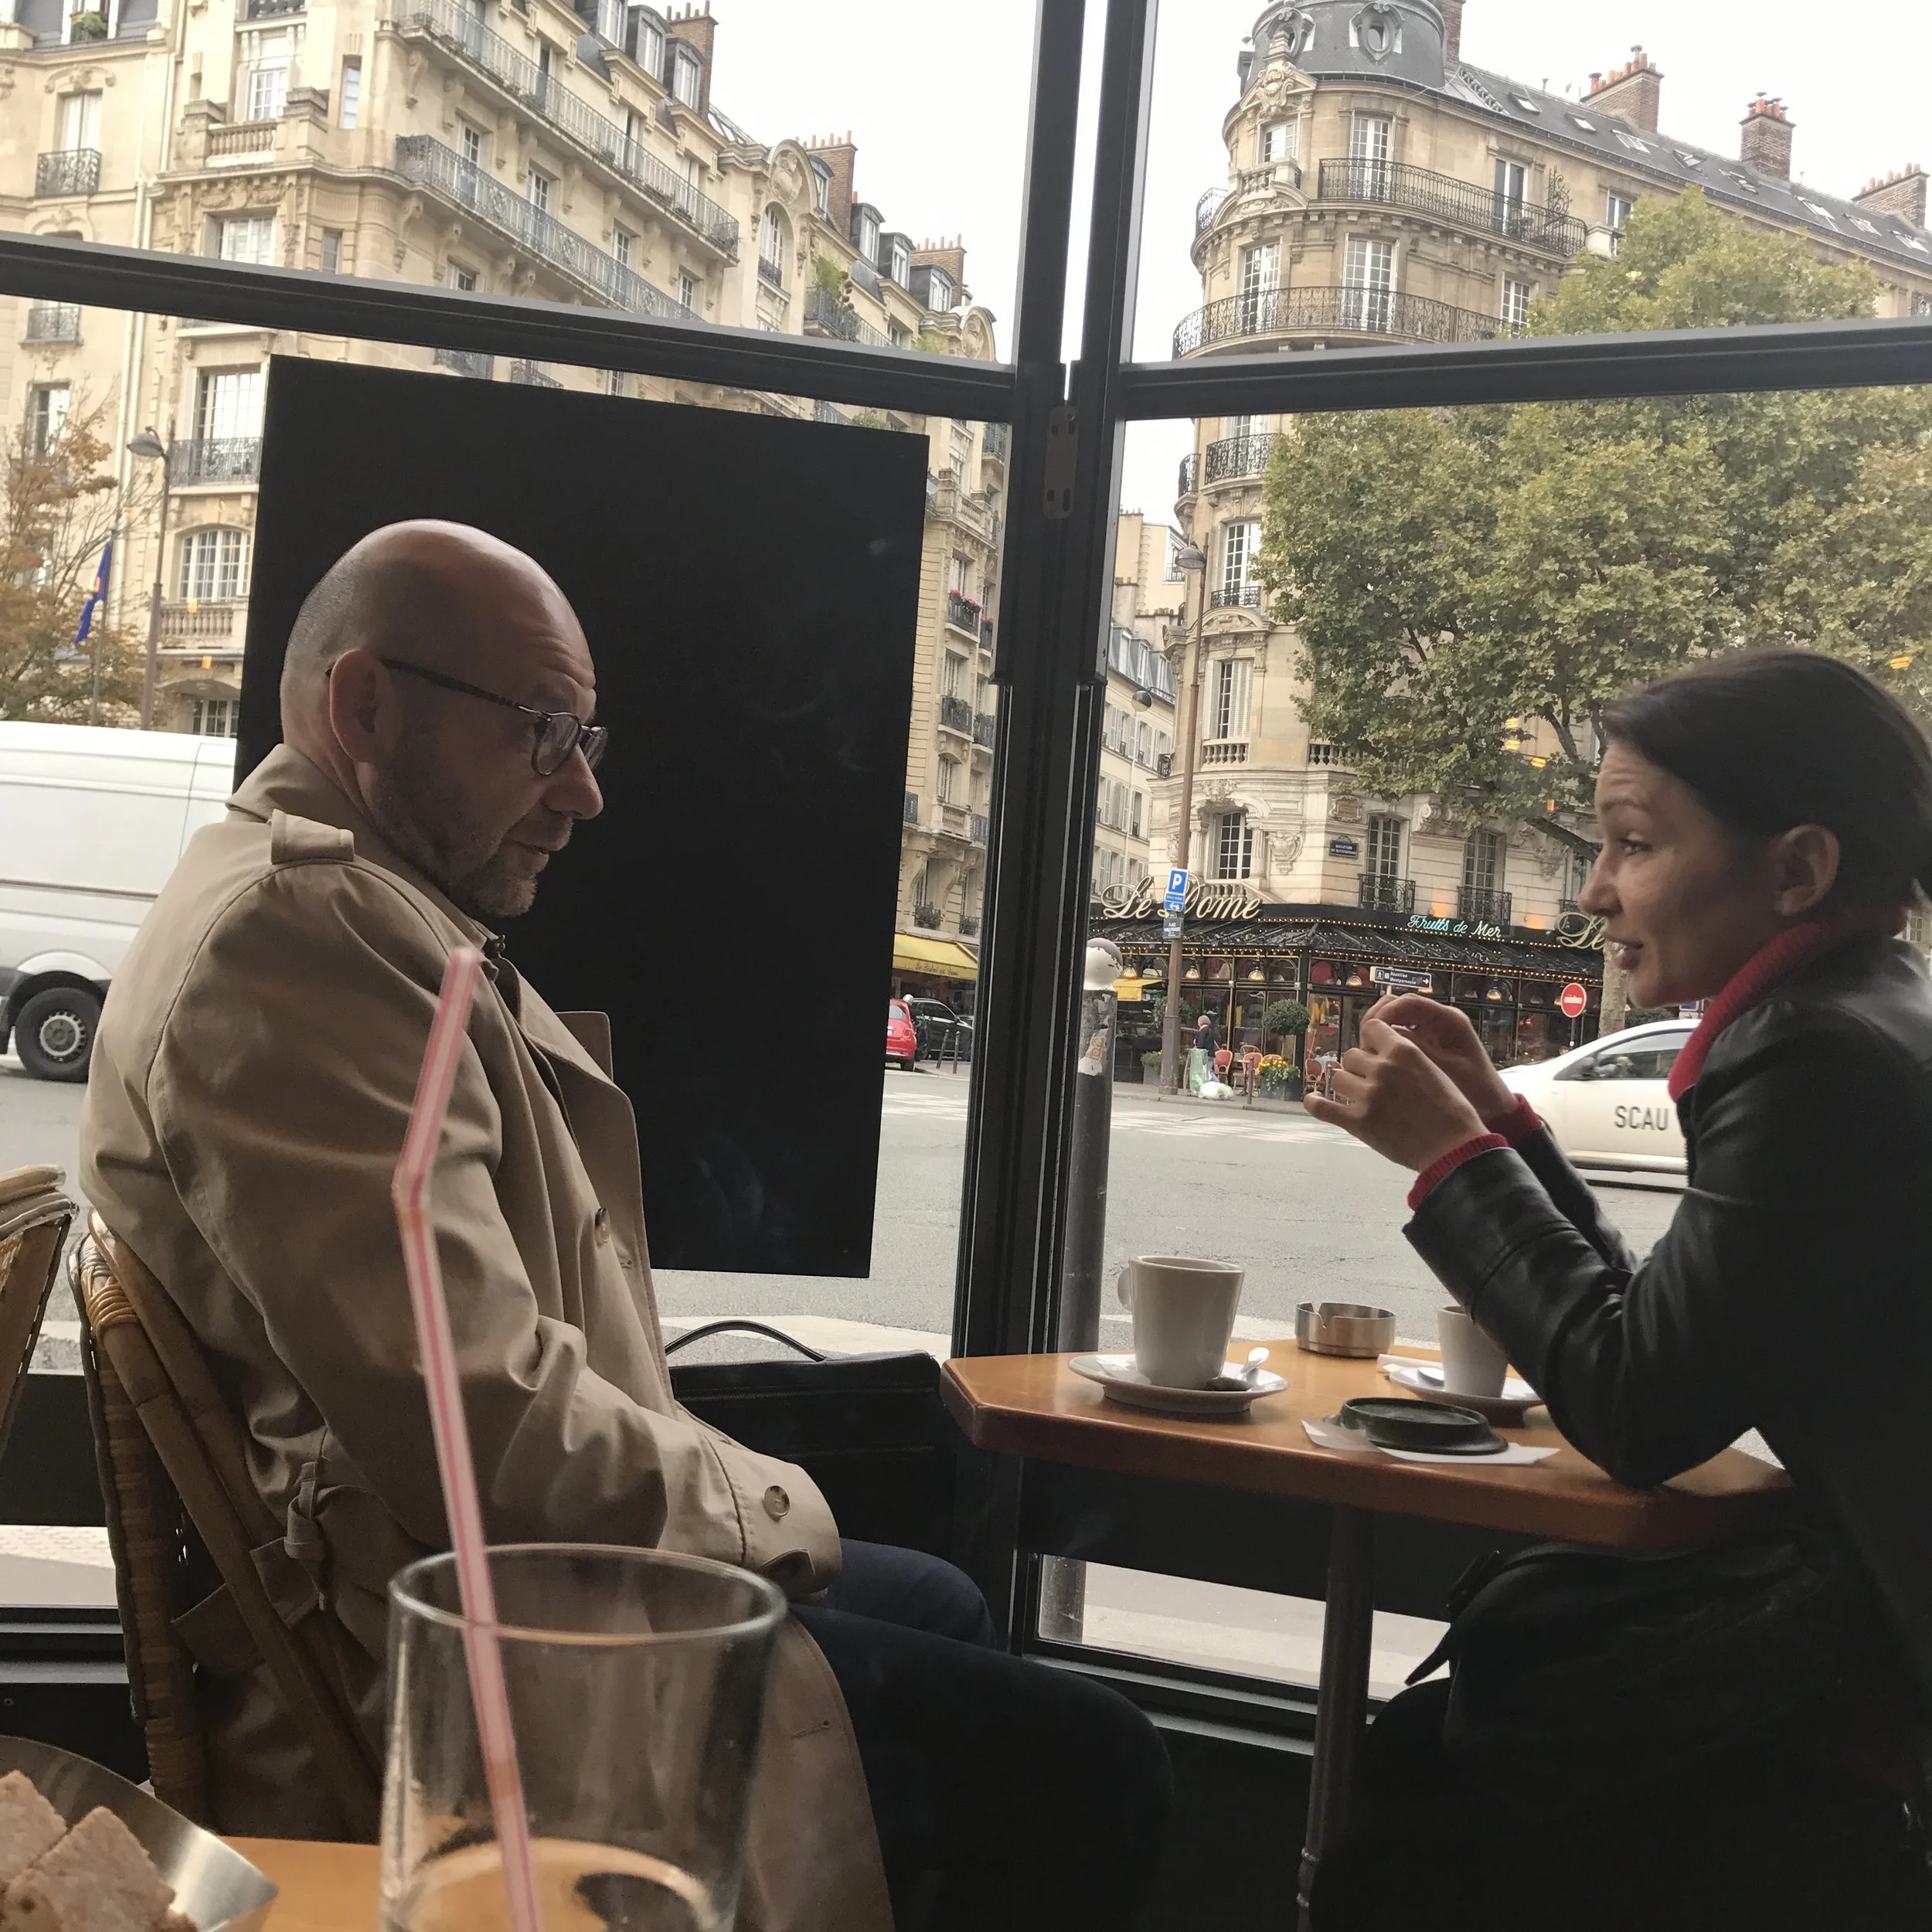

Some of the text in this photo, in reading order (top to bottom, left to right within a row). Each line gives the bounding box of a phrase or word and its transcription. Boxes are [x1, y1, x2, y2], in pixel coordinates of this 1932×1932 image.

[1172, 872, 1182, 890] P
[1100, 875, 1154, 919] Le
[1406, 914, 1502, 938] Fruits de Mer
[1614, 1104, 1669, 1131] SCAU
